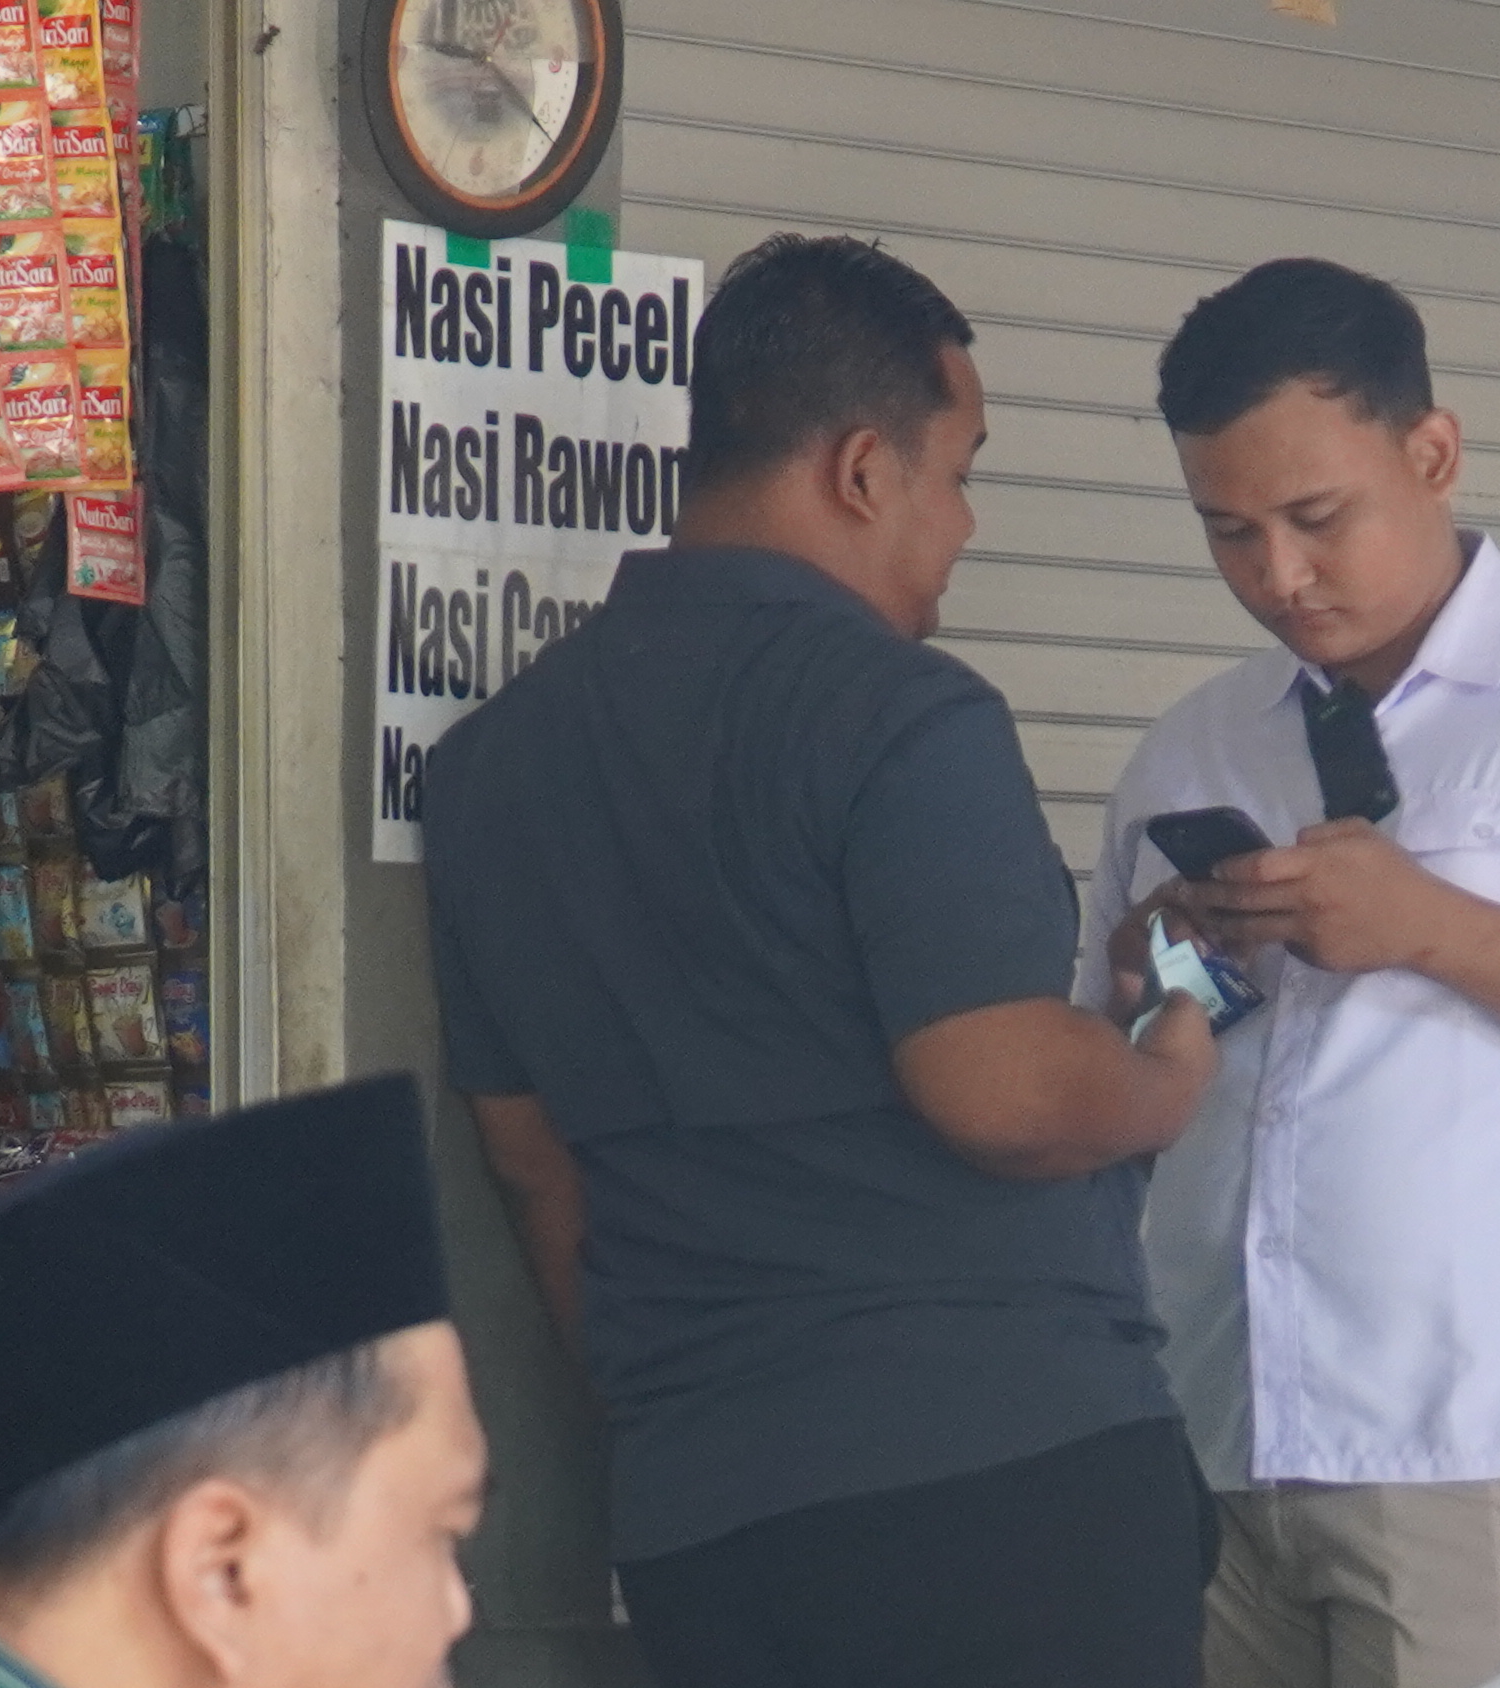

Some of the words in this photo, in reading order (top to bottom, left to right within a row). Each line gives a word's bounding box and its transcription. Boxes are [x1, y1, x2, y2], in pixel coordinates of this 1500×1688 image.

[394, 243, 512, 371] Nasi
[528, 260, 690, 387] Pecel
[77, 508, 136, 533] NutriSari
[390, 400, 501, 521] Nasi
[388, 561, 489, 700] Nasi
